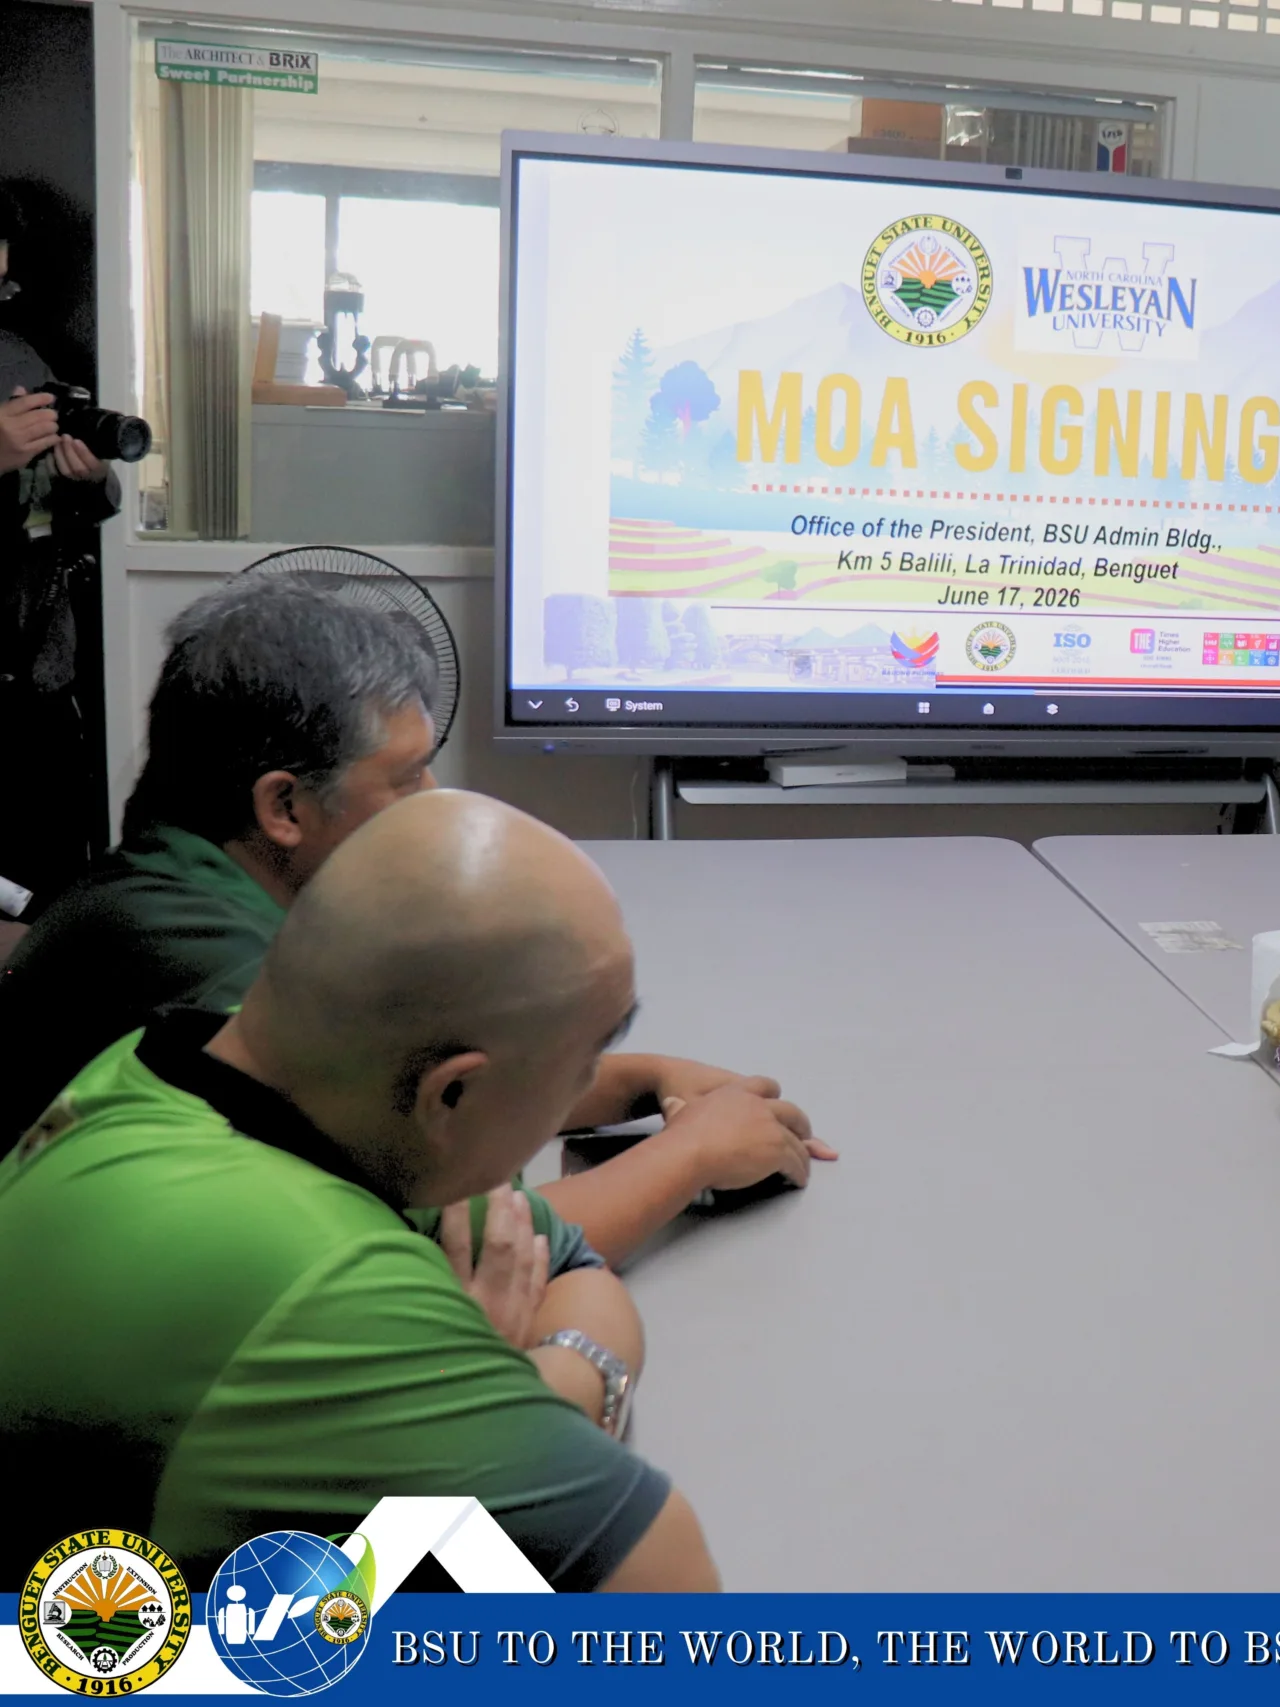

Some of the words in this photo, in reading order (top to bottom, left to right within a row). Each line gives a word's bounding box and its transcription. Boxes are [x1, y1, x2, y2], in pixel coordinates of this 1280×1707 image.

[184, 48, 253, 65] ARCHITECT
[160, 66, 210, 81] Sweet
[217, 70, 314, 91] Partnership
[863, 246, 891, 329] BENGUET
[881, 216, 933, 244] STATE
[942, 219, 991, 330] UNIVERSITY
[1066, 270, 1105, 282] NORTH
[1108, 272, 1163, 287] CAROLINA
[1023, 267, 1197, 330] WESLEYAN
[1053, 313, 1166, 337] UNIVERSITY
[905, 331, 946, 345] 1916
[736, 369, 918, 468] MOA
[791, 515, 856, 537] Office
[862, 518, 885, 538] of
[889, 520, 923, 539] the
[930, 519, 1036, 545] President,
[1043, 523, 1090, 545] BSU
[1093, 526, 1159, 547] Admin
[1166, 528, 1222, 554] Bldg.,
[837, 550, 873, 571] Km
[880, 551, 893, 571] 5
[899, 551, 958, 576] Balili,
[965, 554, 990, 574] La
[999, 554, 1086, 579] Trinidad,
[1093, 558, 1180, 583] Benguet
[938, 585, 989, 607] June
[997, 587, 1025, 609] 17,
[1033, 588, 1081, 608] 2026
[1053, 632, 1092, 648] ISO
[1134, 632, 1152, 650] THE
[625, 700, 663, 713] System
